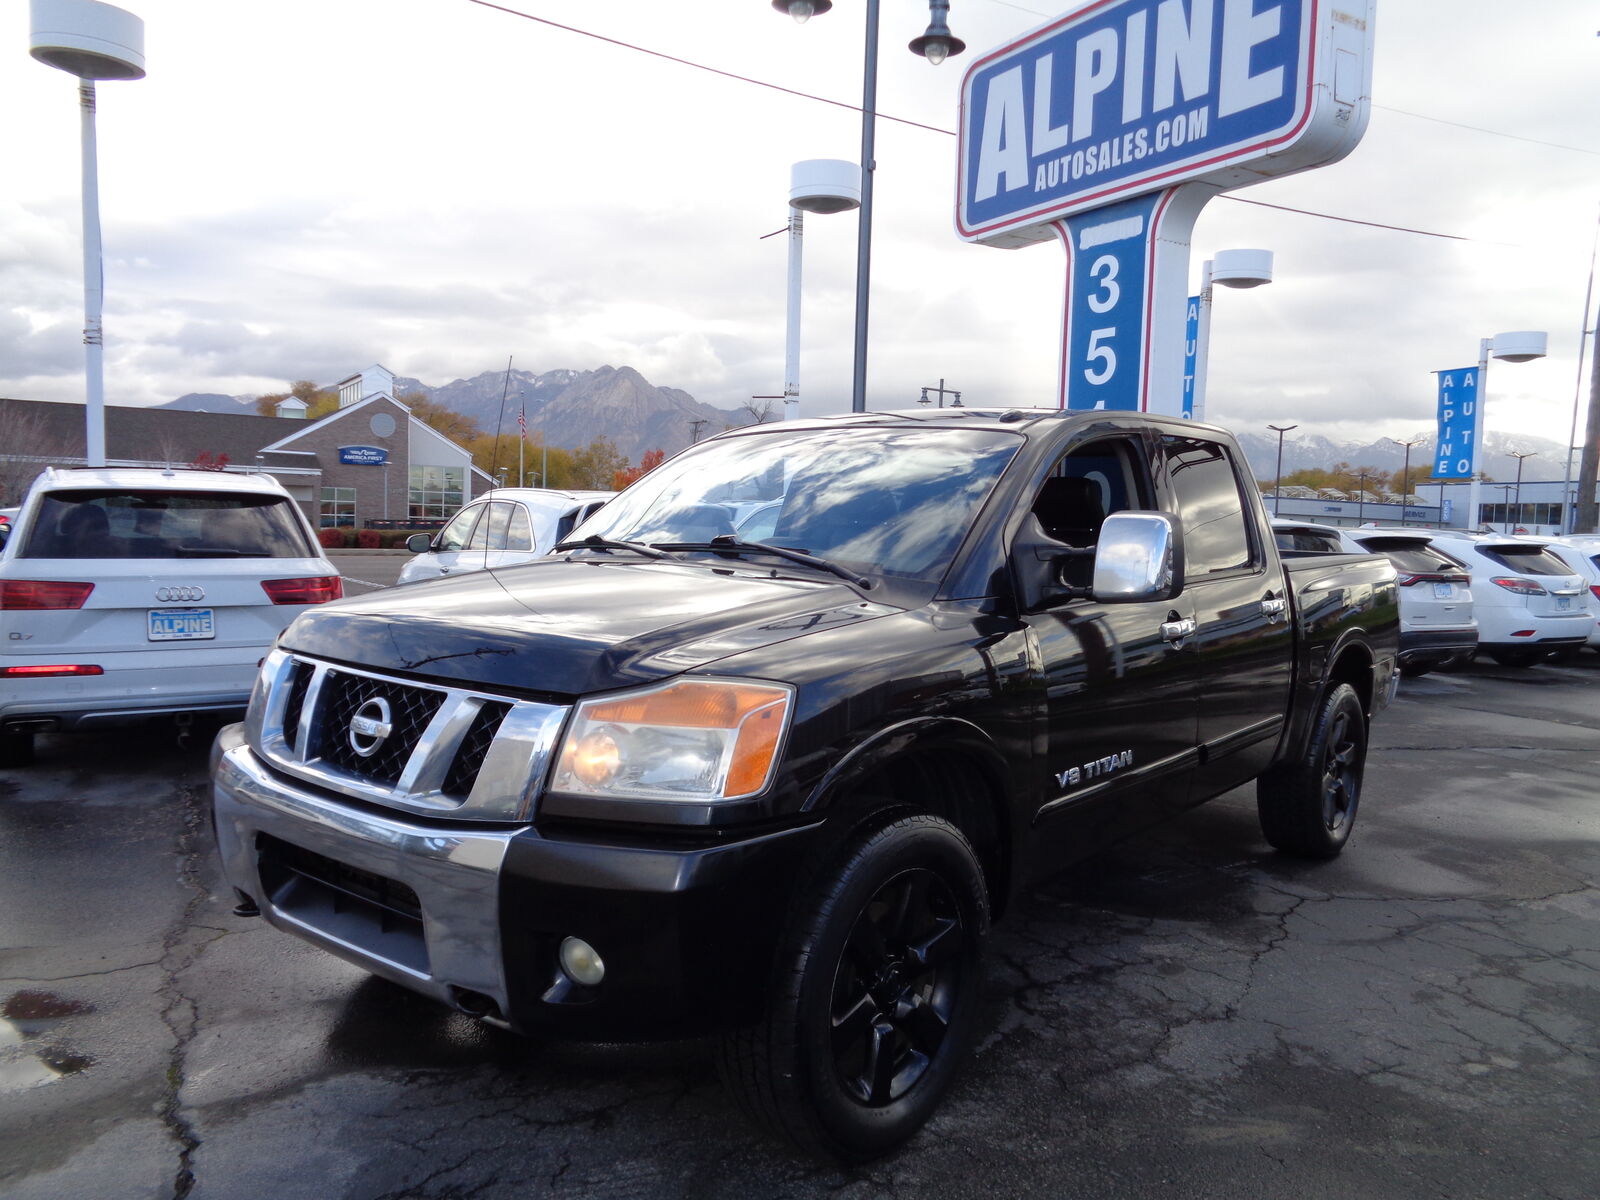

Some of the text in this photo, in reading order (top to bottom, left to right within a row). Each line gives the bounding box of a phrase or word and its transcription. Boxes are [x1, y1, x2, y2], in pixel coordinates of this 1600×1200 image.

[974, 0, 1284, 203] ALPINE
[1034, 105, 1209, 193] AUTOSALES.COM
[1438, 374, 1454, 474] ALPINE
[1457, 372, 1475, 474] AUTO
[152, 618, 211, 634] ALPINE
[1055, 749, 1132, 789] V8 TITAN
